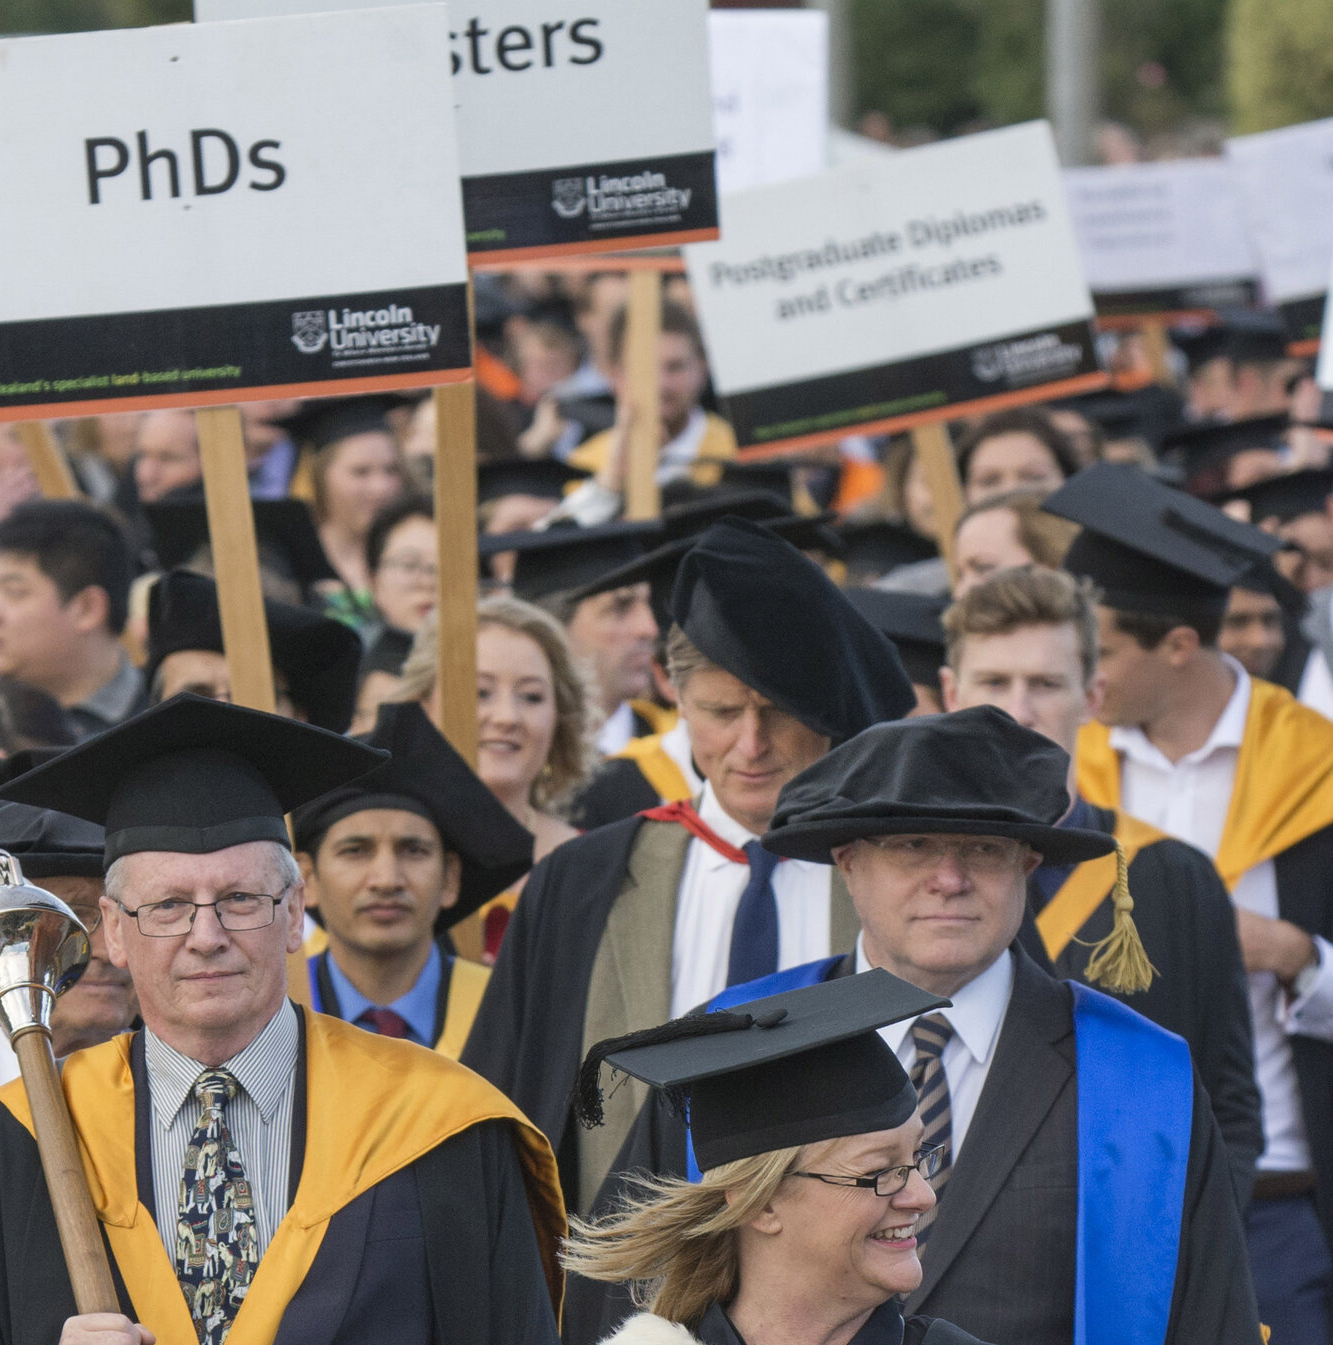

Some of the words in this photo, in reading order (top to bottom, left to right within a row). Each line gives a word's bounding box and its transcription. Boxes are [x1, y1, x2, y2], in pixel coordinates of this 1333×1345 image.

[85, 128, 287, 205] PhDs
[586, 170, 666, 194] Lincoln
[587, 186, 692, 213] University
[710, 228, 903, 287] Postgraduate
[906, 198, 1047, 249] Diplomas
[776, 287, 831, 321] and
[836, 253, 1003, 306] Certificates
[328, 304, 413, 330] Lincoln
[329, 322, 442, 350] University
